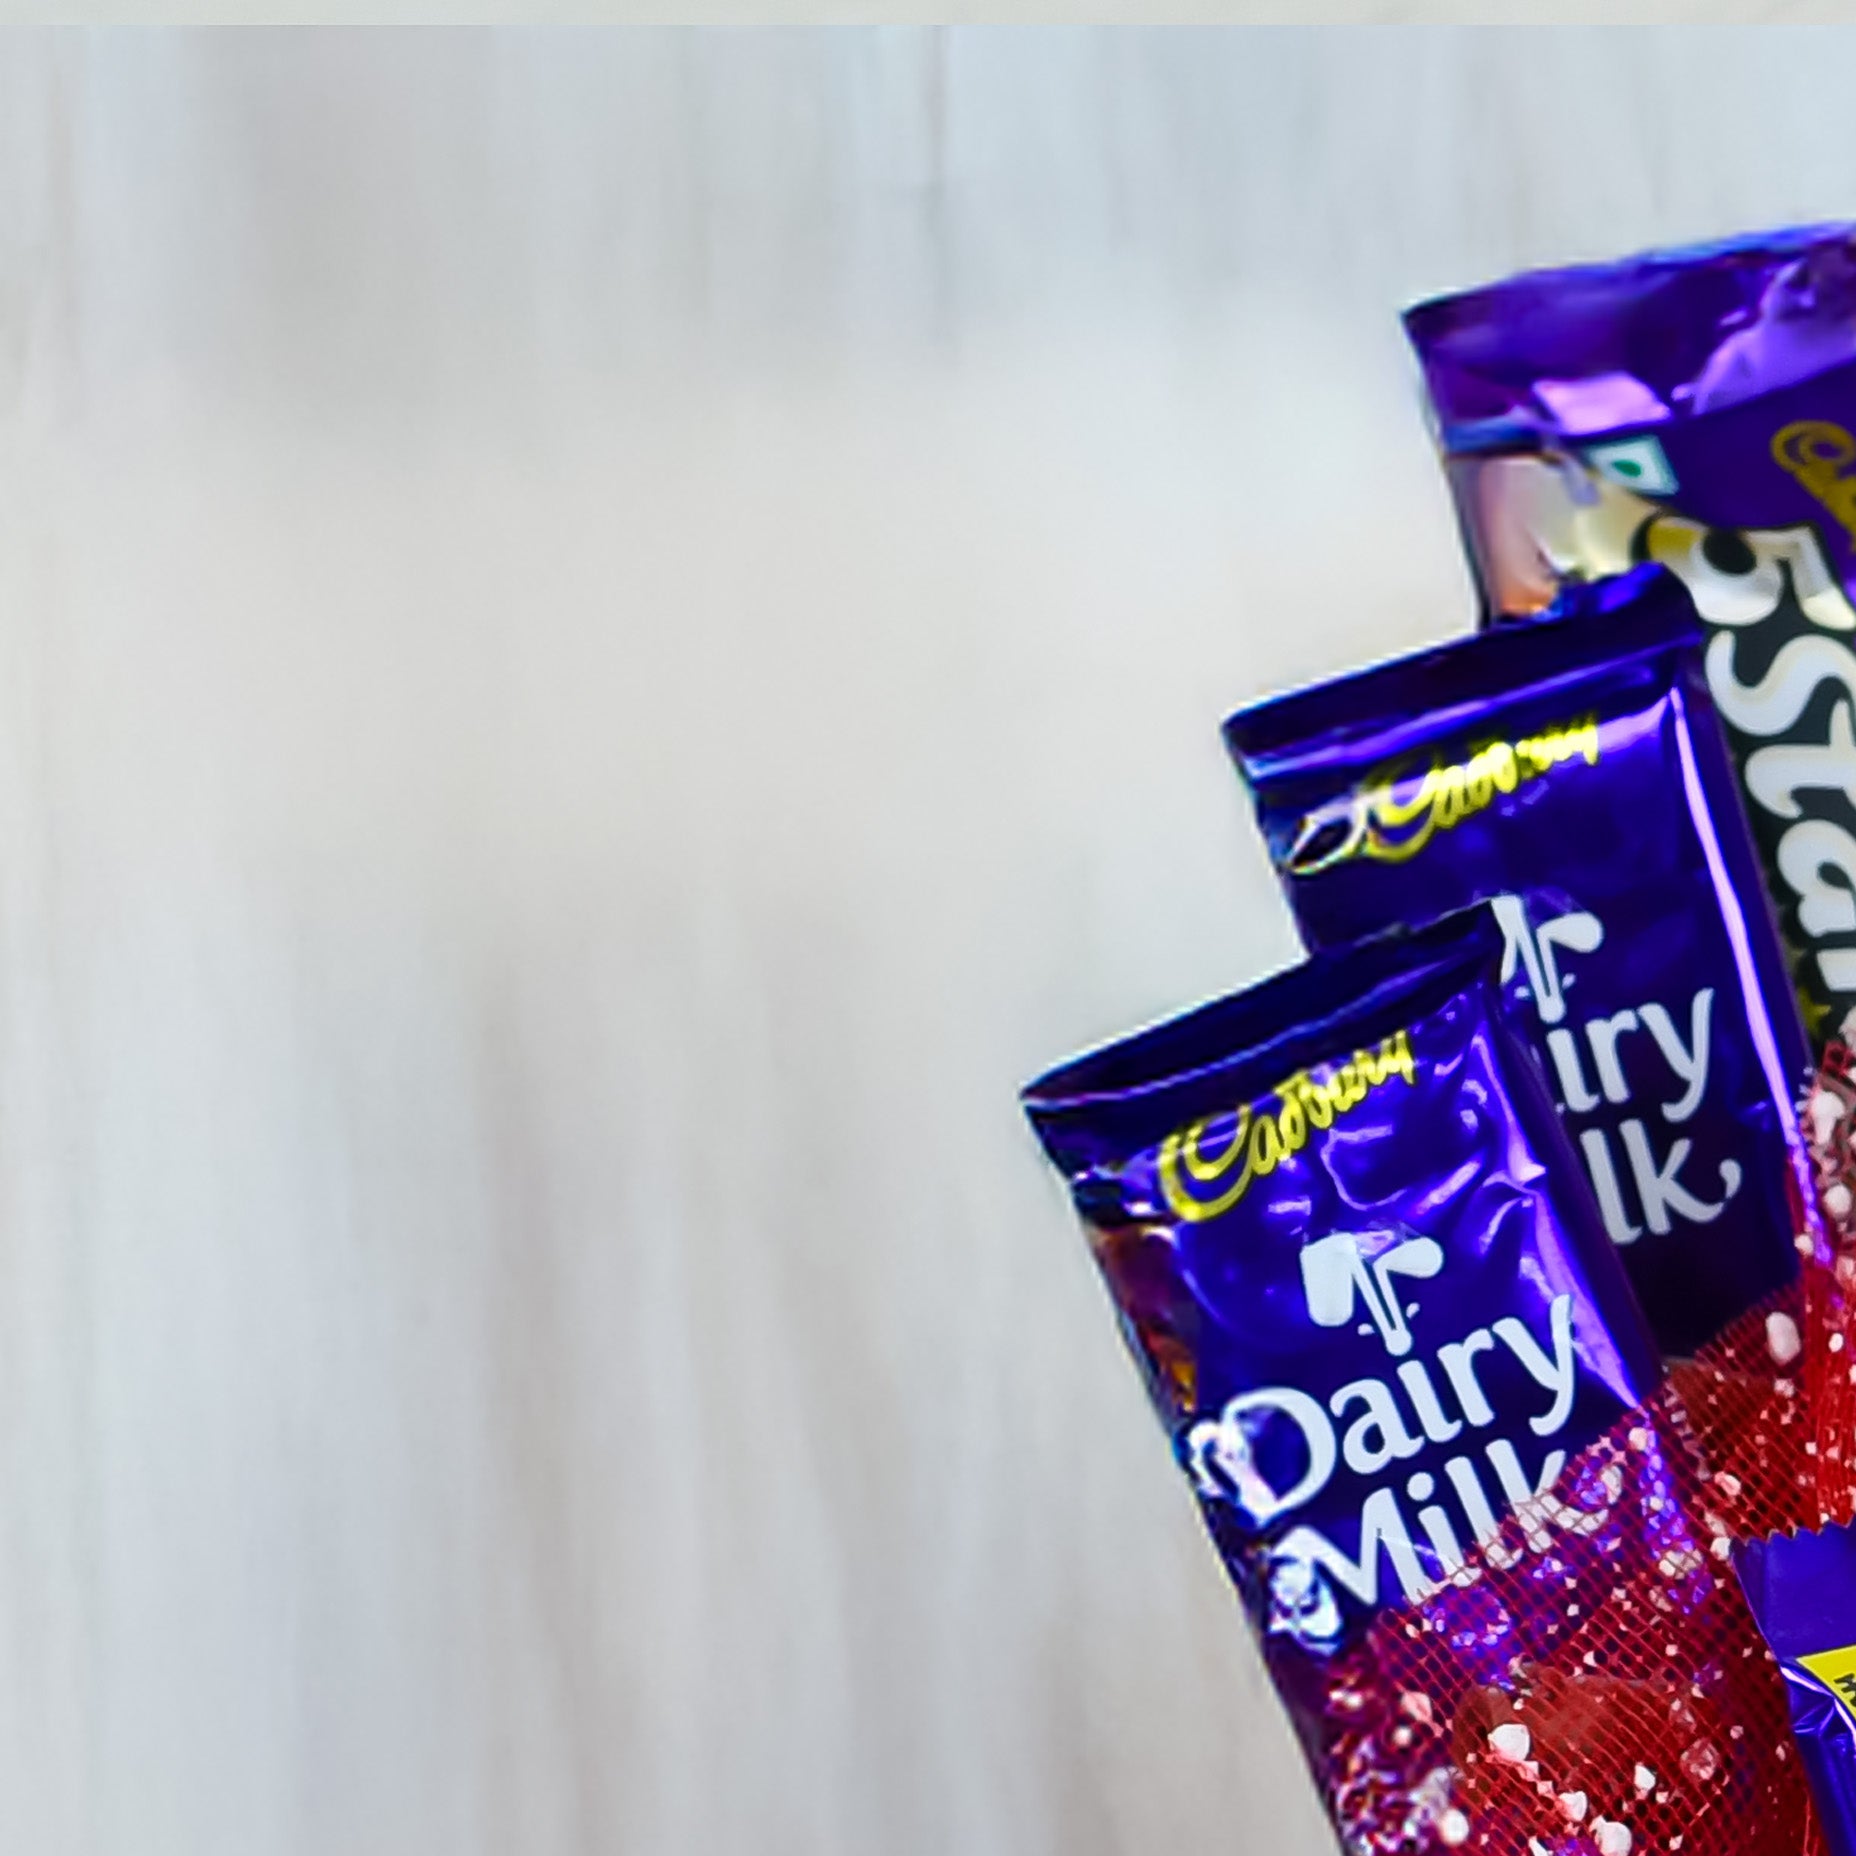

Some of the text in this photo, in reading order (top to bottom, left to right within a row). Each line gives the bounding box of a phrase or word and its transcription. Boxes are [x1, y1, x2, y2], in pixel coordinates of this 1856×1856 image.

[1157, 1029, 1416, 1222] Cadbury
[1546, 988, 1715, 1122] iry
[1580, 1118, 1742, 1244] lk
[1190, 1295, 1577, 1526] Dairy
[1268, 1438, 1622, 1655] Milk
